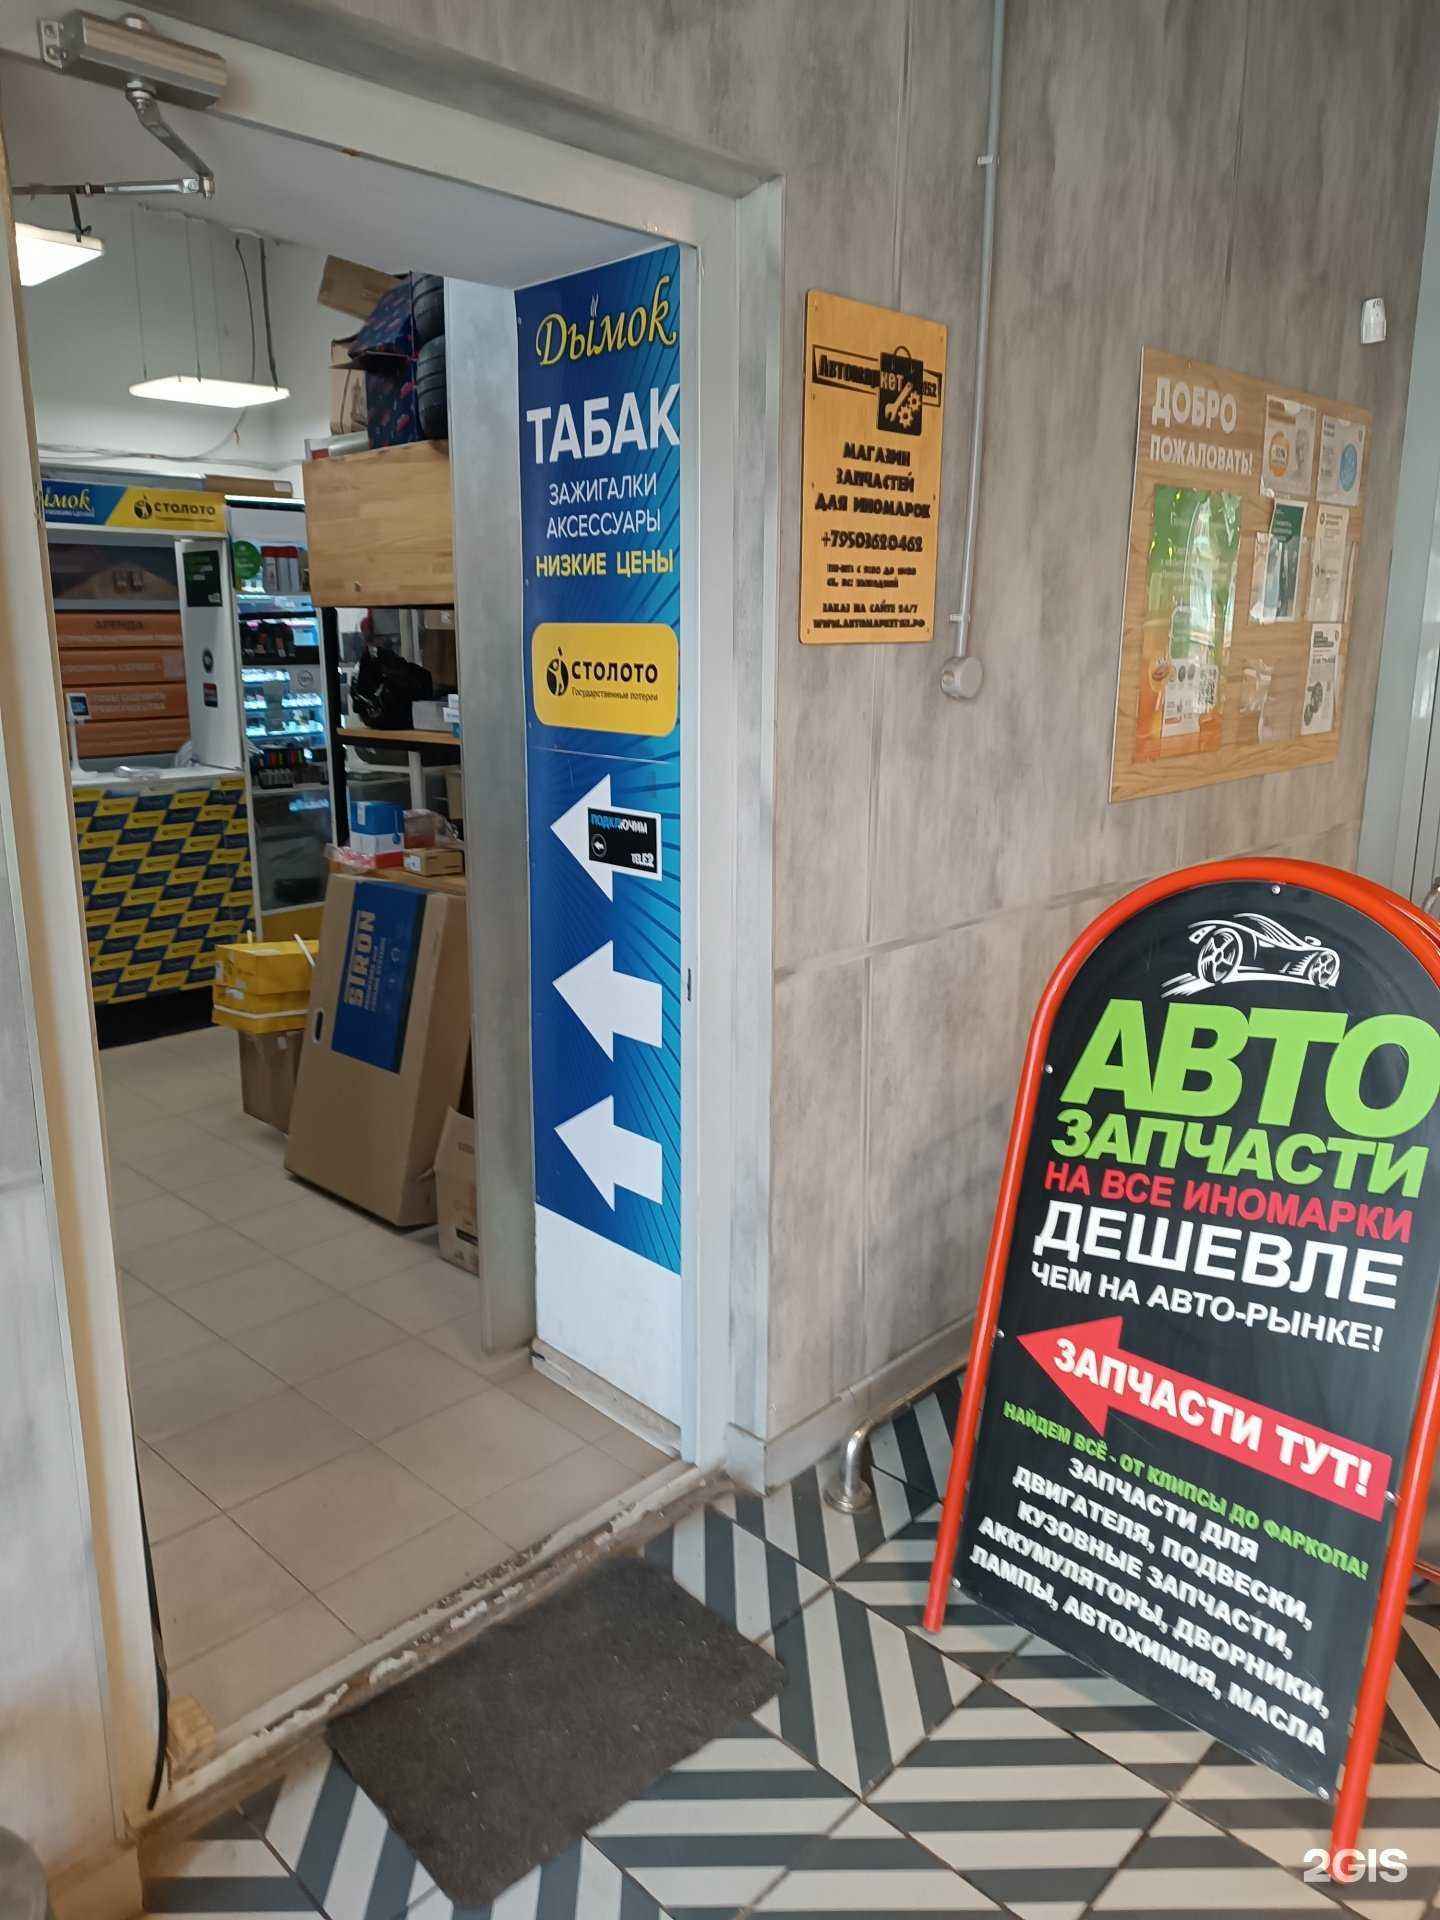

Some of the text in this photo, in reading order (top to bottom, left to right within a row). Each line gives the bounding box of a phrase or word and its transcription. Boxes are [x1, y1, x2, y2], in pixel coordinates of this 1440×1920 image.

[536, 276, 677, 365] Дымок
[526, 383, 680, 465] ТАБАК
[1151, 376, 1238, 434] ДОБРО
[548, 472, 657, 506] ЗАЖИГАЛКИ
[836, 467, 915, 493] ЗАПЧАСТЕЙ
[843, 441, 910, 467] МАГАЗИН
[1150, 434, 1253, 477] ПОЖАЛОВАТЬ!
[154, 501, 216, 516] СТОЛОТО
[546, 508, 661, 539] АКСЕССУАРЫ
[815, 493, 931, 518] ДЛЯ ИНОМАРОК
[535, 548, 673, 578] НИЗКИЕ ЦЕНЫ
[571, 661, 658, 683] СТОЛОТО
[1060, 998, 1440, 1138] АВТО
[1051, 1108, 1430, 1198] ЗАПЧАСТИ
[1044, 1160, 1413, 1244] НА ВСЕ ИНОМАРКИ
[1033, 1199, 1404, 1309] ДЕШЕВЛЕ
[1031, 1261, 1384, 1352] ЧЕМ НА АВТО-РЫНКЕ!
[1053, 1338, 1372, 1498] ЗАПЧАСТИ ТУТ!
[1003, 1400, 1071, 1445] НАЙДЕМ
[1073, 1432, 1109, 1462] ВСЁ
[1119, 1453, 1145, 1478] ОТ
[1147, 1464, 1227, 1516] КЛИПСЫ
[1228, 1502, 1260, 1530] ДО
[1263, 1519, 1369, 1582] ФАРКОПА!
[1068, 1457, 1259, 1563] ЗАПЧАСТИ ДЛЯ
[1012, 1465, 1312, 1631] ДВИГАТЕЛЯ, ПОДВЕСКИ,
[1017, 1500, 1293, 1661] КУЗОВНЫЕ ЗАПЧАСТИ,
[969, 1544, 1326, 1756] ЛАМПЫ, АВТОХИМИЯ, МАСЛА
[978, 1516, 1330, 1720] АККУМУЛЯТОРЫ, ДВОРНИКИ,
